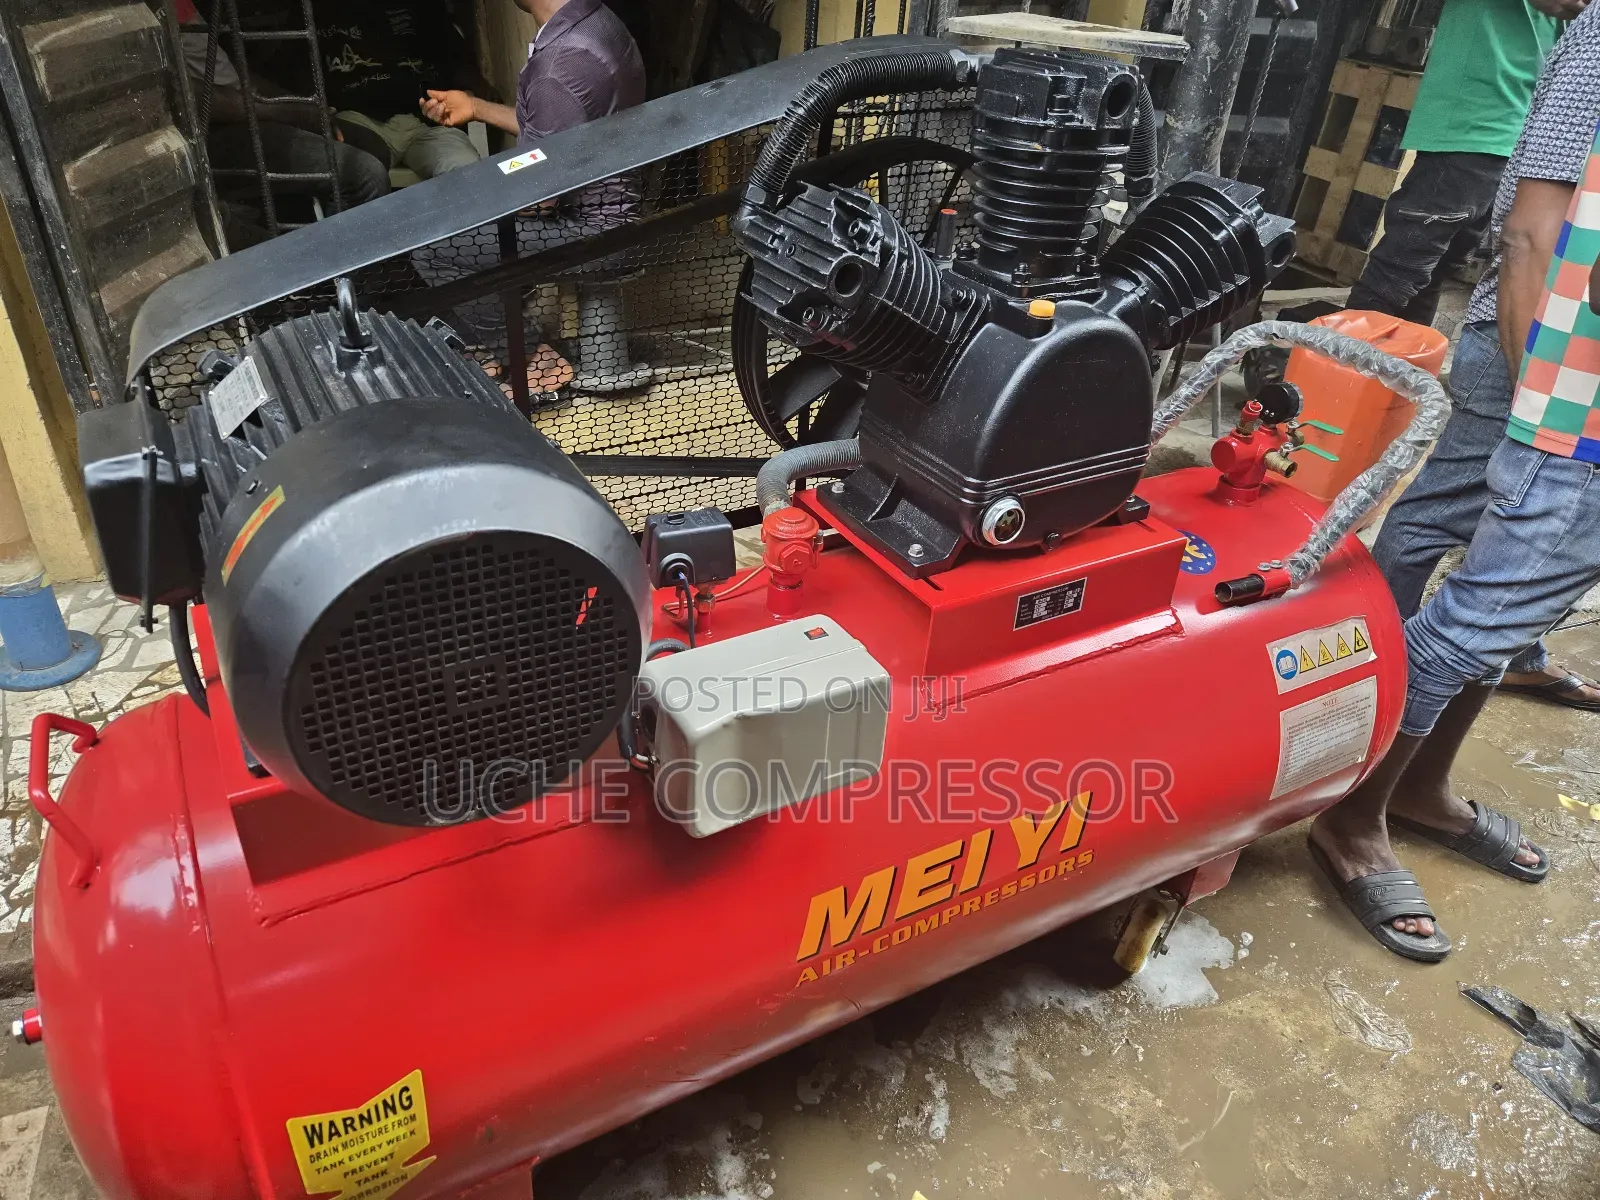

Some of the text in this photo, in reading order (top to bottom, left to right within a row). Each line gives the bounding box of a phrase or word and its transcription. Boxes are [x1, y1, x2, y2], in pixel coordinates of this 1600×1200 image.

[796, 789, 1094, 963] MEI YI
[796, 849, 1095, 989] AIR-COMPRESSORS
[302, 1085, 414, 1149] WARNING
[309, 1113, 417, 1164] DRAIN MOISTURE FROM
[315, 1129, 416, 1175] TANK EVERY WEEK
[343, 1152, 395, 1179] PREVENT
[343, 1173, 408, 1200] ORROSION
[355, 1169, 388, 1187] TANK
